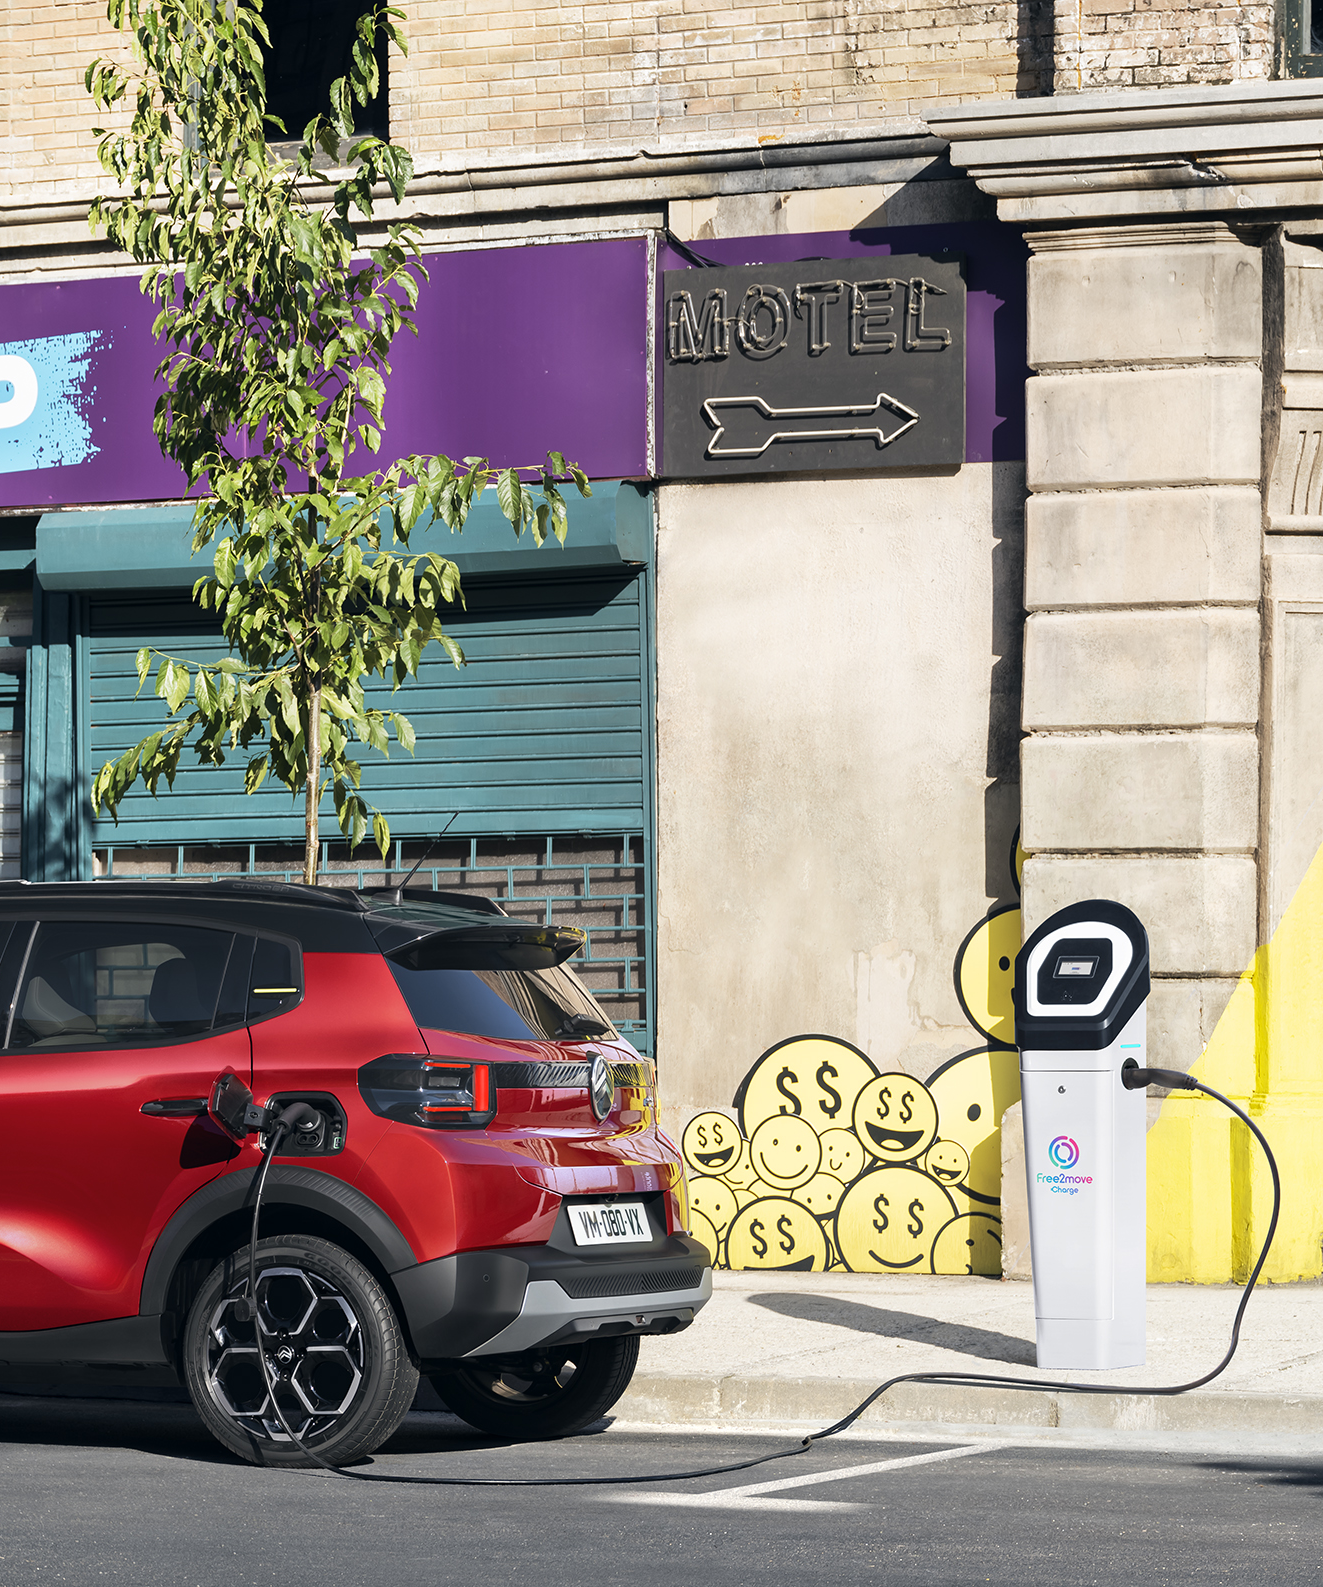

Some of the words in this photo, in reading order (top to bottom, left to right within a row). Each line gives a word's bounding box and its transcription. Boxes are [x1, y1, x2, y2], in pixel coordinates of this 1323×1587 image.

[667, 277, 952, 362] MOTEL
[1036, 1172, 1094, 1184] Free2move
[1050, 1185, 1079, 1196] Charge
